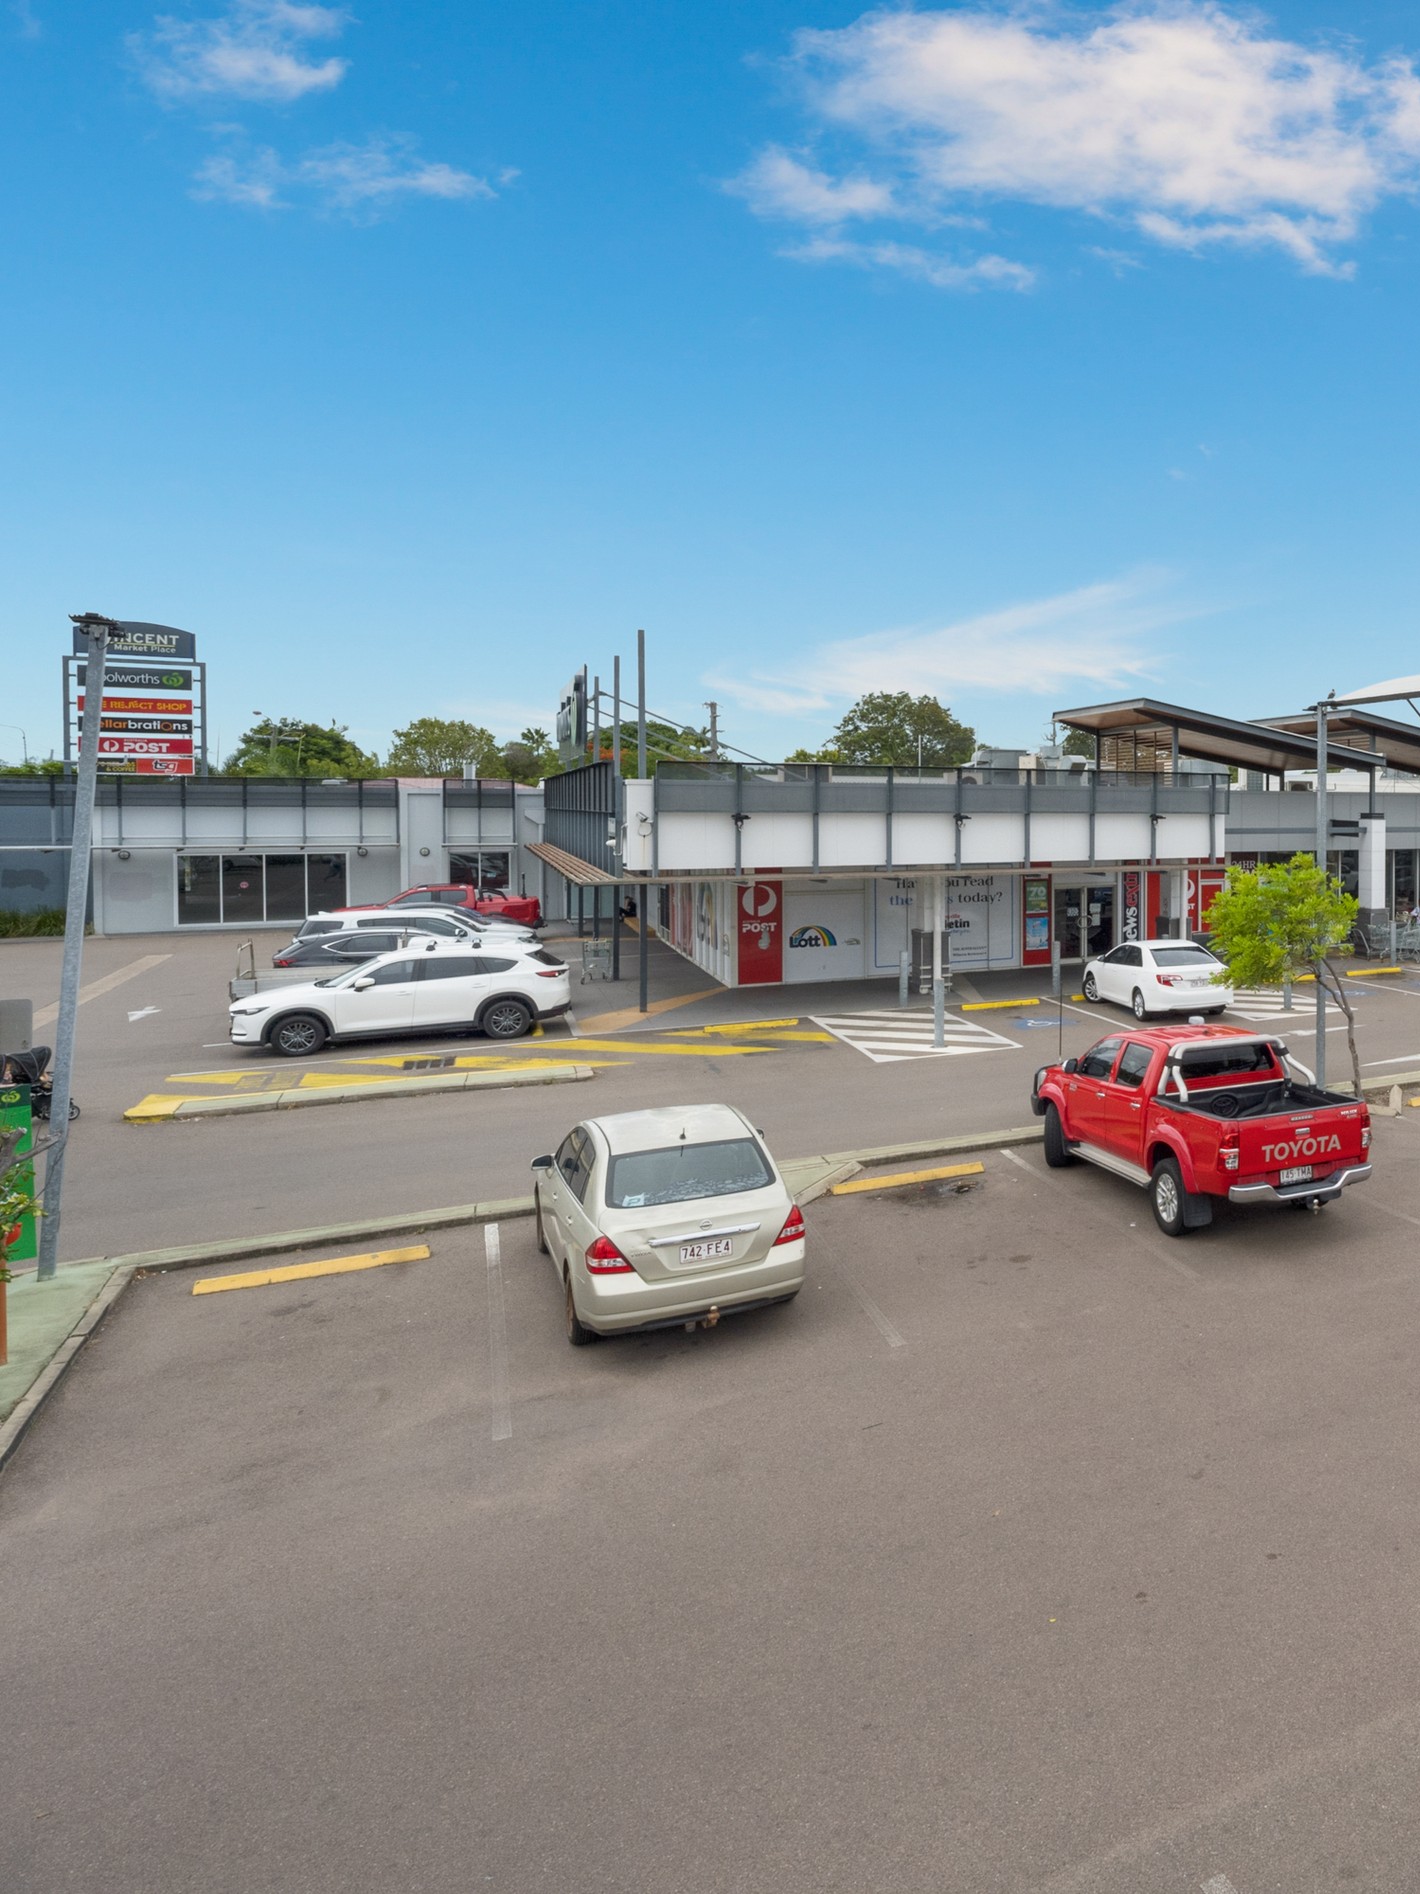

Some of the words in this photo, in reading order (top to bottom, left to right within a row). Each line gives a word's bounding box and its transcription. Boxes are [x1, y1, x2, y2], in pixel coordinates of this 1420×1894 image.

[114, 643, 148, 653] Market
[151, 645, 176, 653] Place
[102, 672, 160, 685] olworths
[110, 700, 153, 710] REJECT
[156, 702, 187, 711] SHOP
[100, 720, 188, 732] ellarbrations
[123, 742, 171, 753] POST
[896, 877, 918, 888] Ha
[962, 876, 994, 887] read
[889, 895, 913, 906] the
[958, 891, 1003, 905] today?
[742, 922, 778, 933] POST
[789, 935, 821, 949] Lott
[1261, 1134, 1342, 1163] TOYOTA
